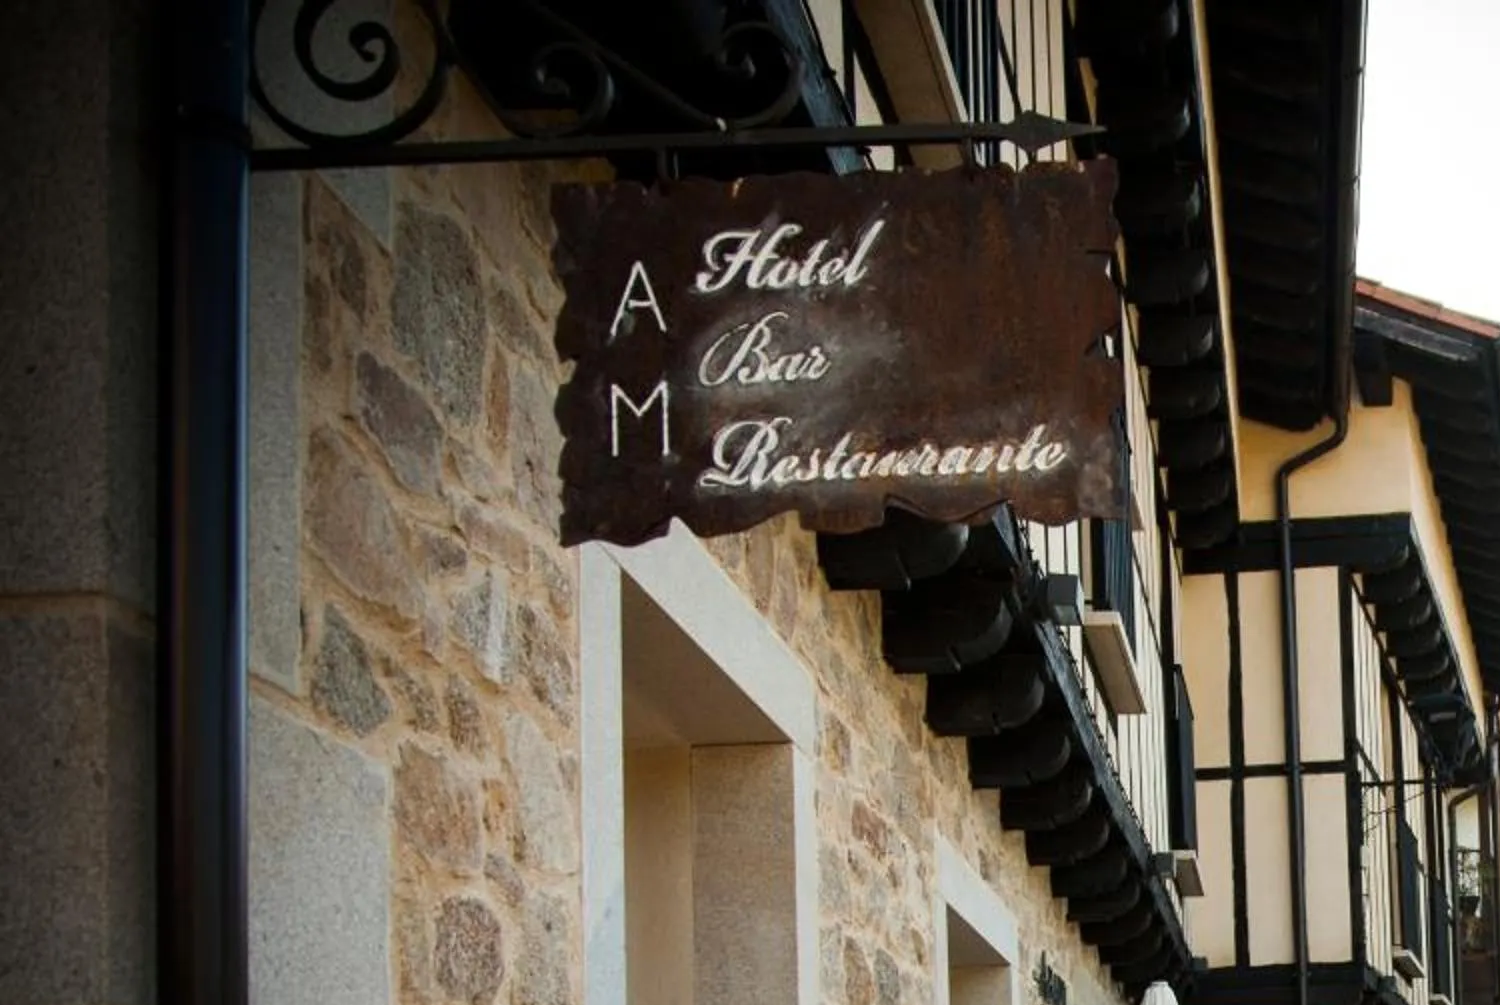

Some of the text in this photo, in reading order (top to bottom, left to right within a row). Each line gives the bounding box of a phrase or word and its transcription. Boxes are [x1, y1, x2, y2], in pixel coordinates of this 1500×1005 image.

[697, 219, 886, 293] Hotel
[611, 261, 667, 336] A
[700, 312, 831, 387] Bar
[609, 381, 670, 458] M
[700, 417, 1068, 490] Restaurante
